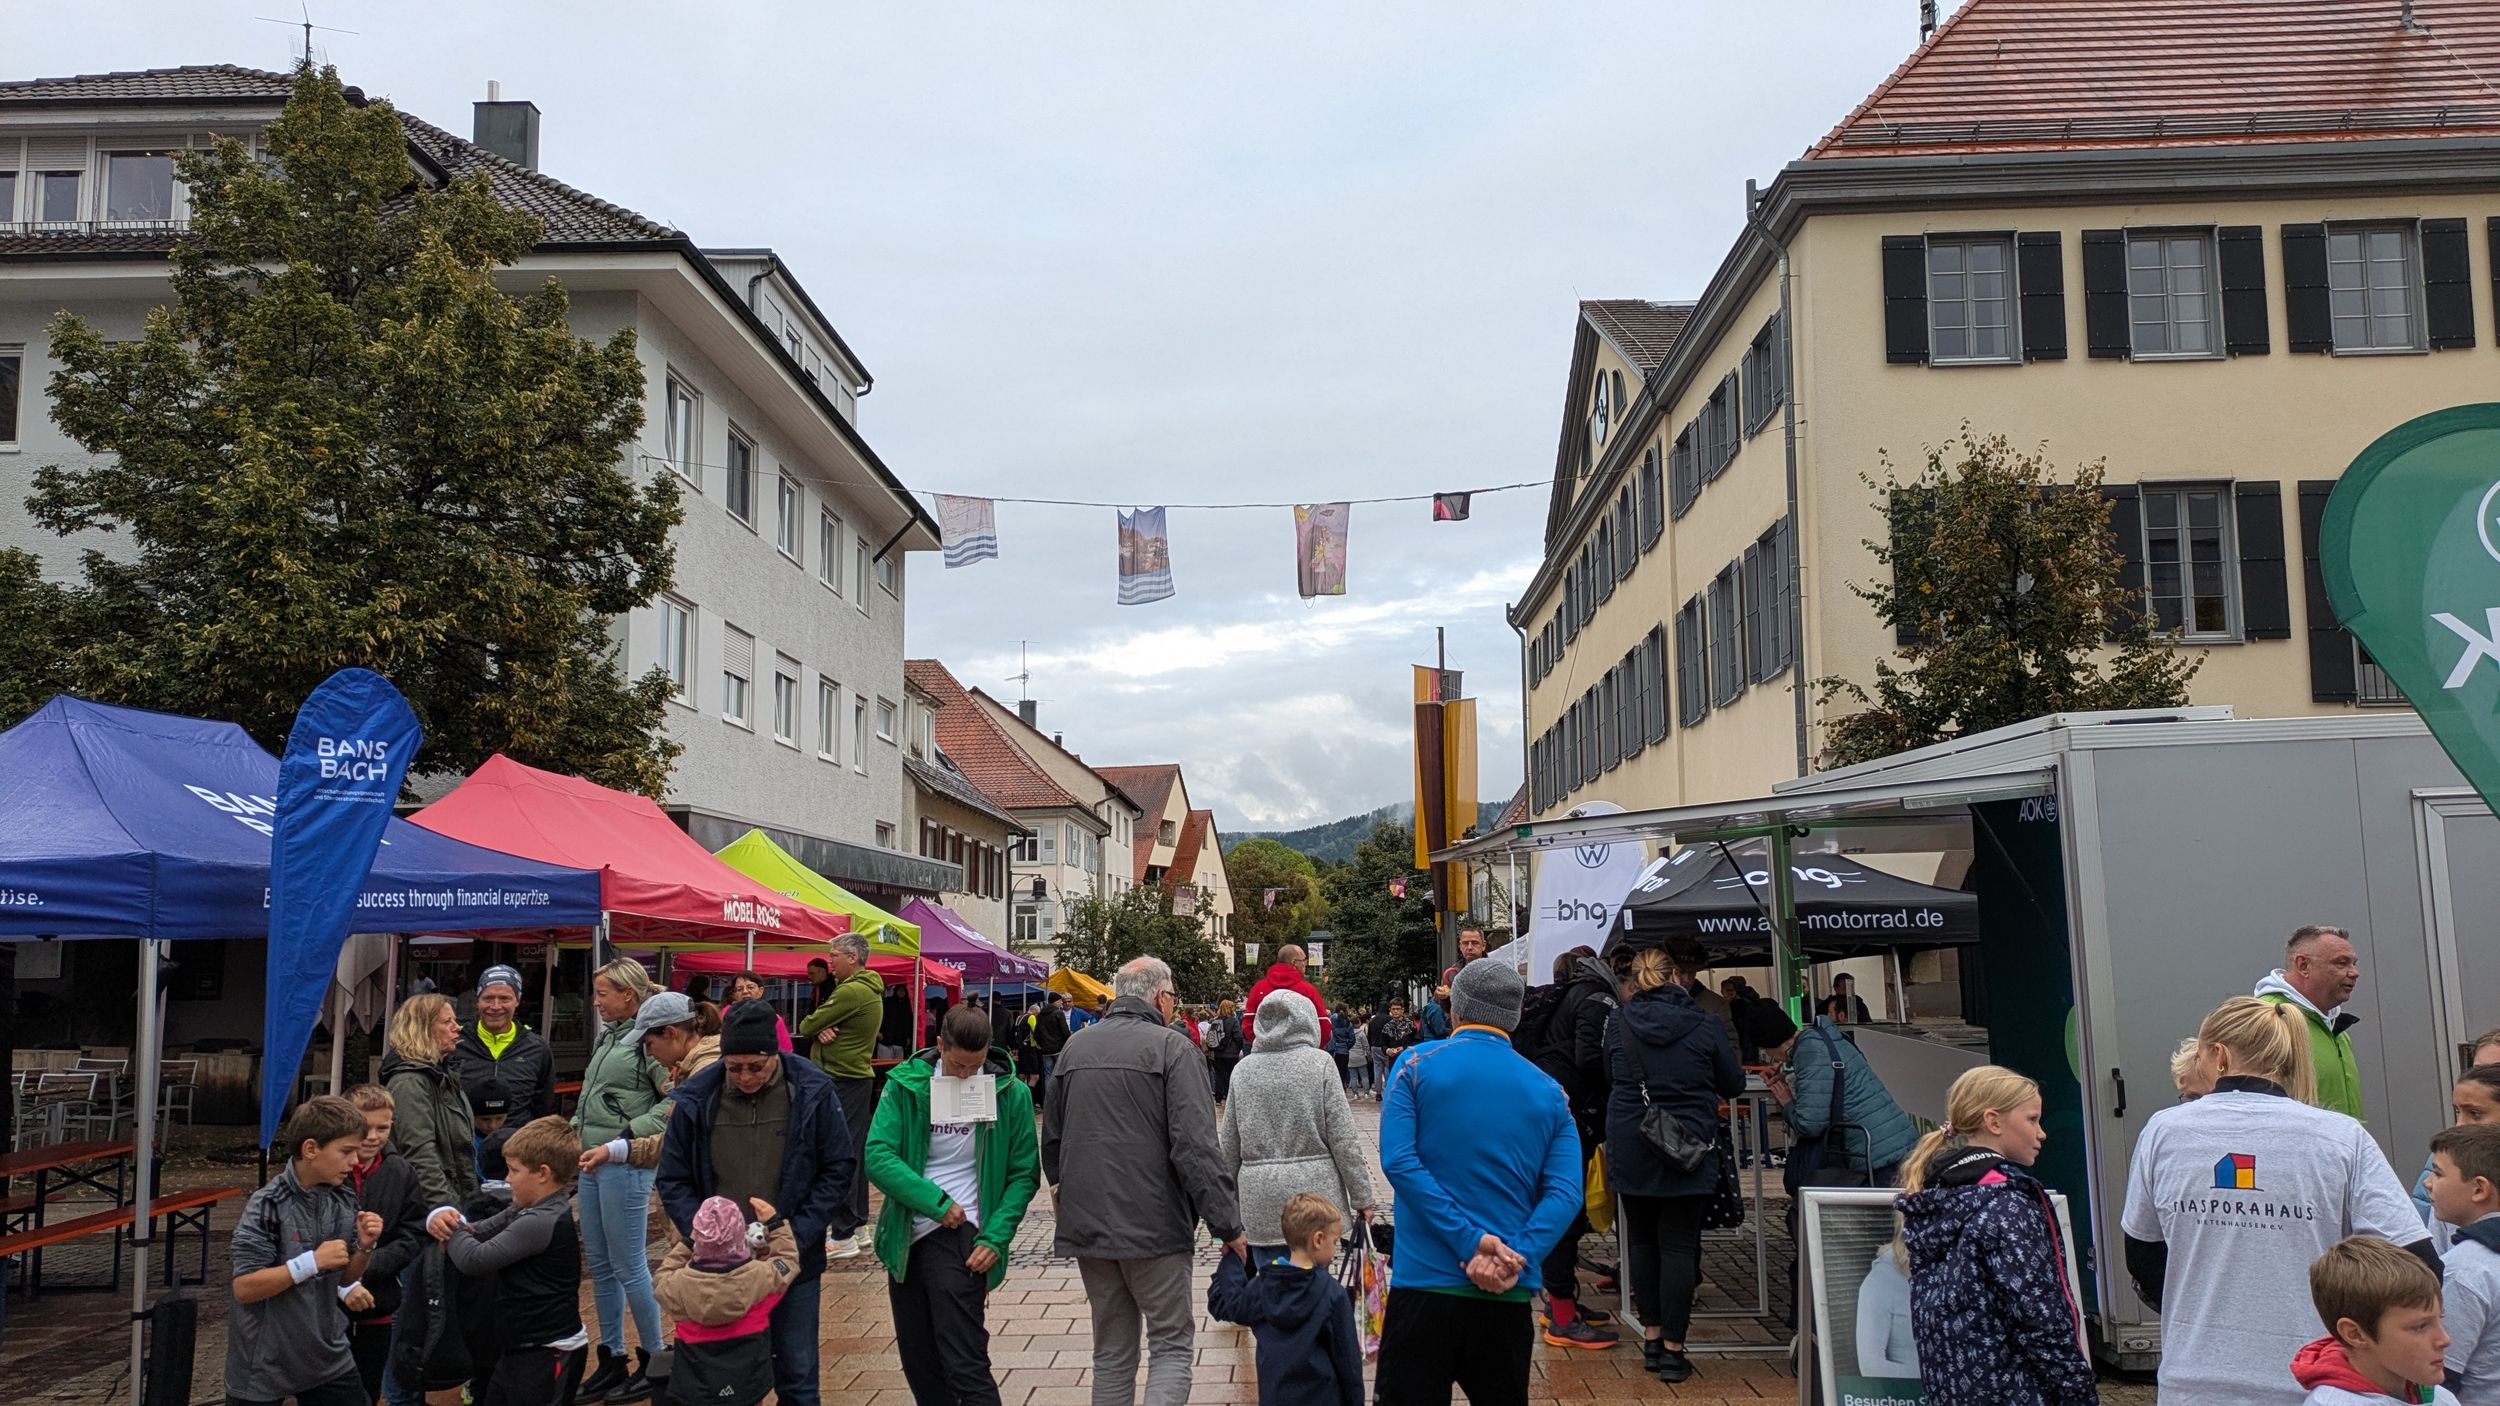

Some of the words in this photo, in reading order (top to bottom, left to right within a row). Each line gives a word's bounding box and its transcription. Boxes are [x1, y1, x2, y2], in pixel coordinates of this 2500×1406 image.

[317, 736, 389, 760] BANS
[320, 758, 388, 782] BACH
[2019, 797, 2045, 823] AOK
[409, 889, 454, 911] through
[457, 888, 501, 908] financial
[504, 889, 550, 909] expertise.
[723, 894, 755, 923] MÖBEL
[1558, 898, 1608, 930] bhg
[1697, 908, 1944, 933] www.a-motorrad.de
